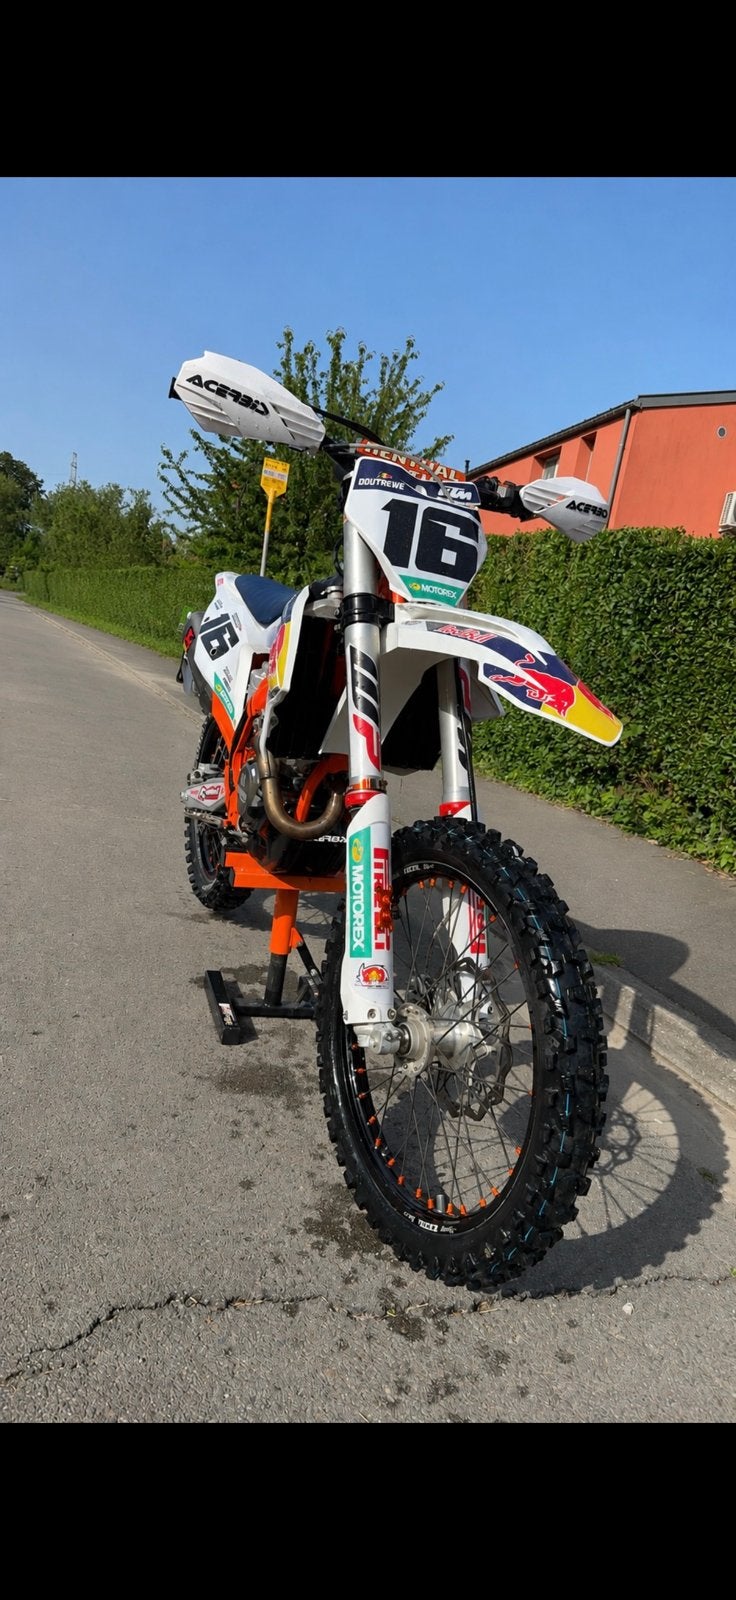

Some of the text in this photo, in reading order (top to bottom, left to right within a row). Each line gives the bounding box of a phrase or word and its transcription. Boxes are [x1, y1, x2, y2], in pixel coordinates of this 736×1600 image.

[358, 478, 404, 491] DOUTREWE
[381, 498, 479, 583] 16
[421, 584, 457, 599] MOTOREX
[199, 613, 239, 661] 16
[352, 864, 365, 951] MOTOREX
